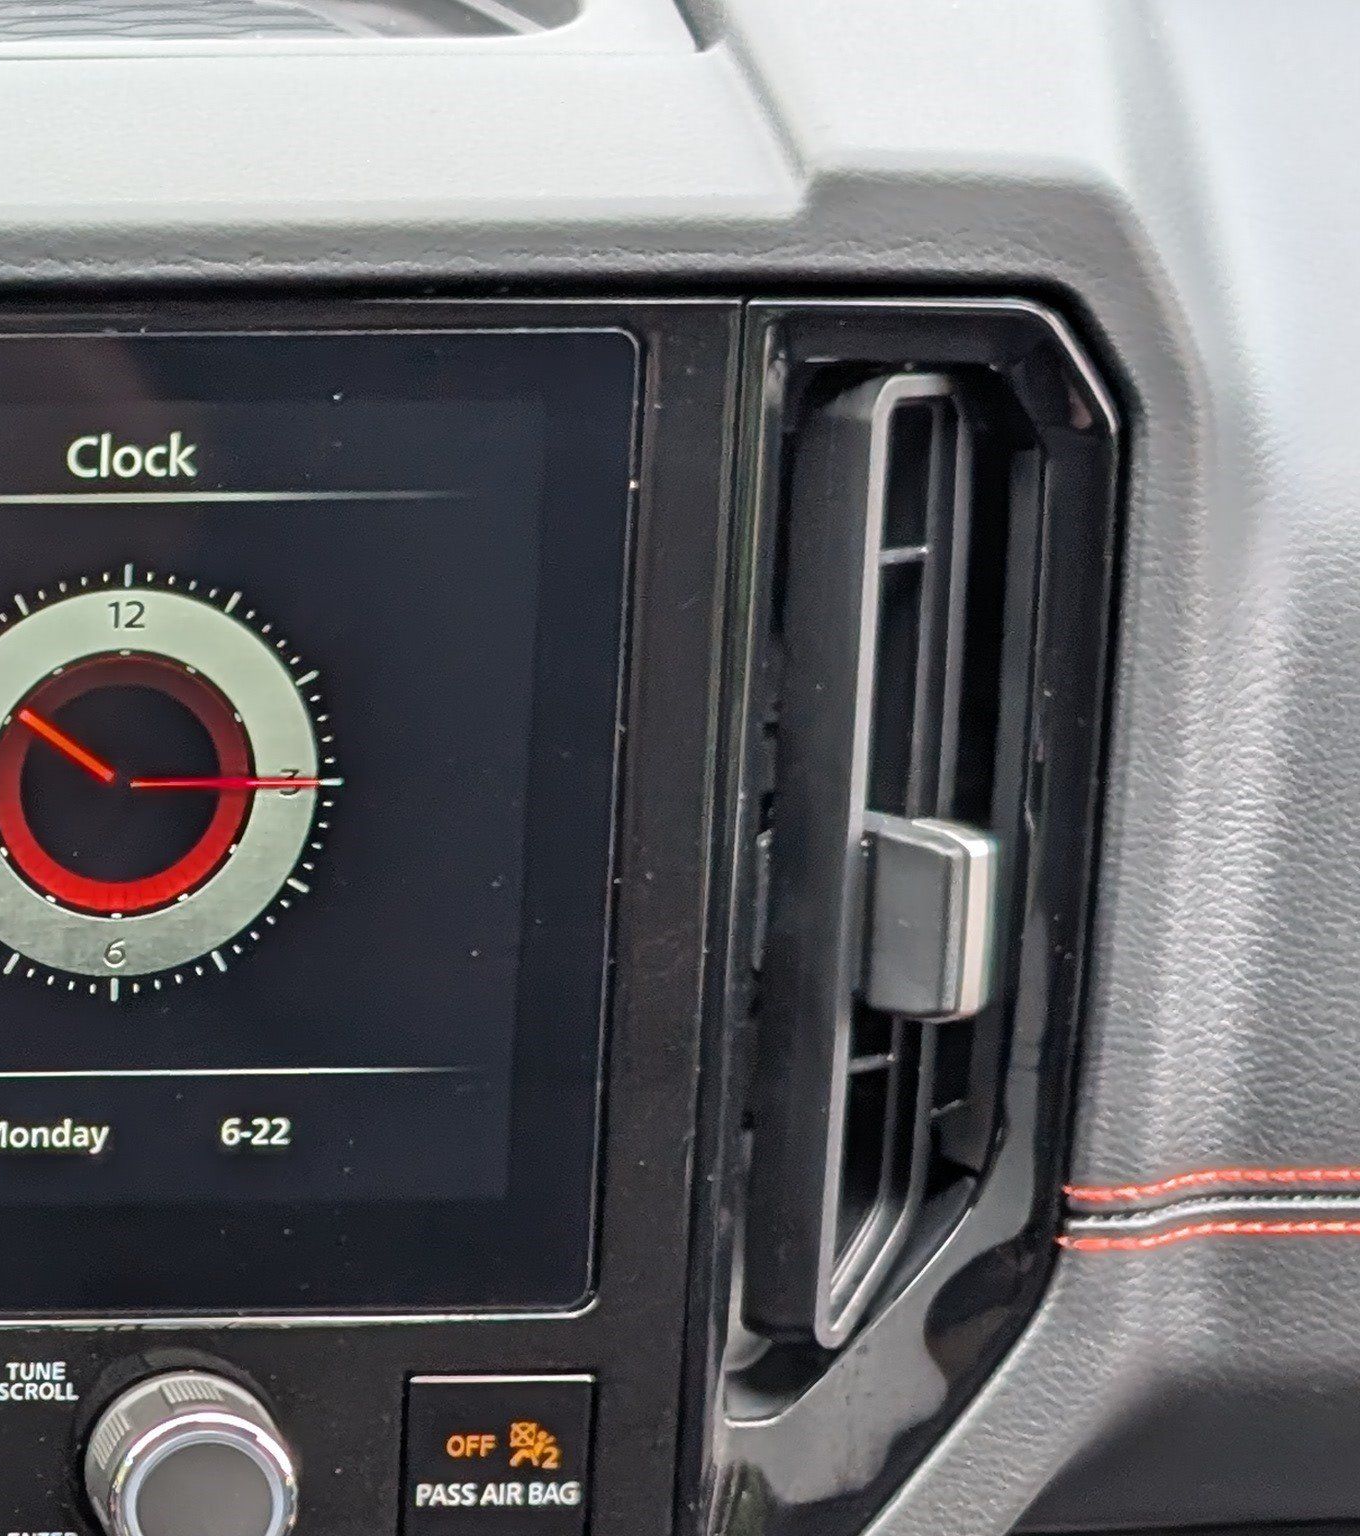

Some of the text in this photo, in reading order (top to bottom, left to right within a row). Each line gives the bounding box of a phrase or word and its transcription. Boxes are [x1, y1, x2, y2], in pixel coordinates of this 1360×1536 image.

[66, 432, 197, 479] Clock
[108, 601, 145, 629] 12
[103, 938, 128, 968] 6
[220, 1117, 292, 1146] 6-22
[5, 1362, 66, 1381] TUNE
[446, 1433, 497, 1458] OFF
[416, 1480, 581, 1507] PASS AIR BAG
